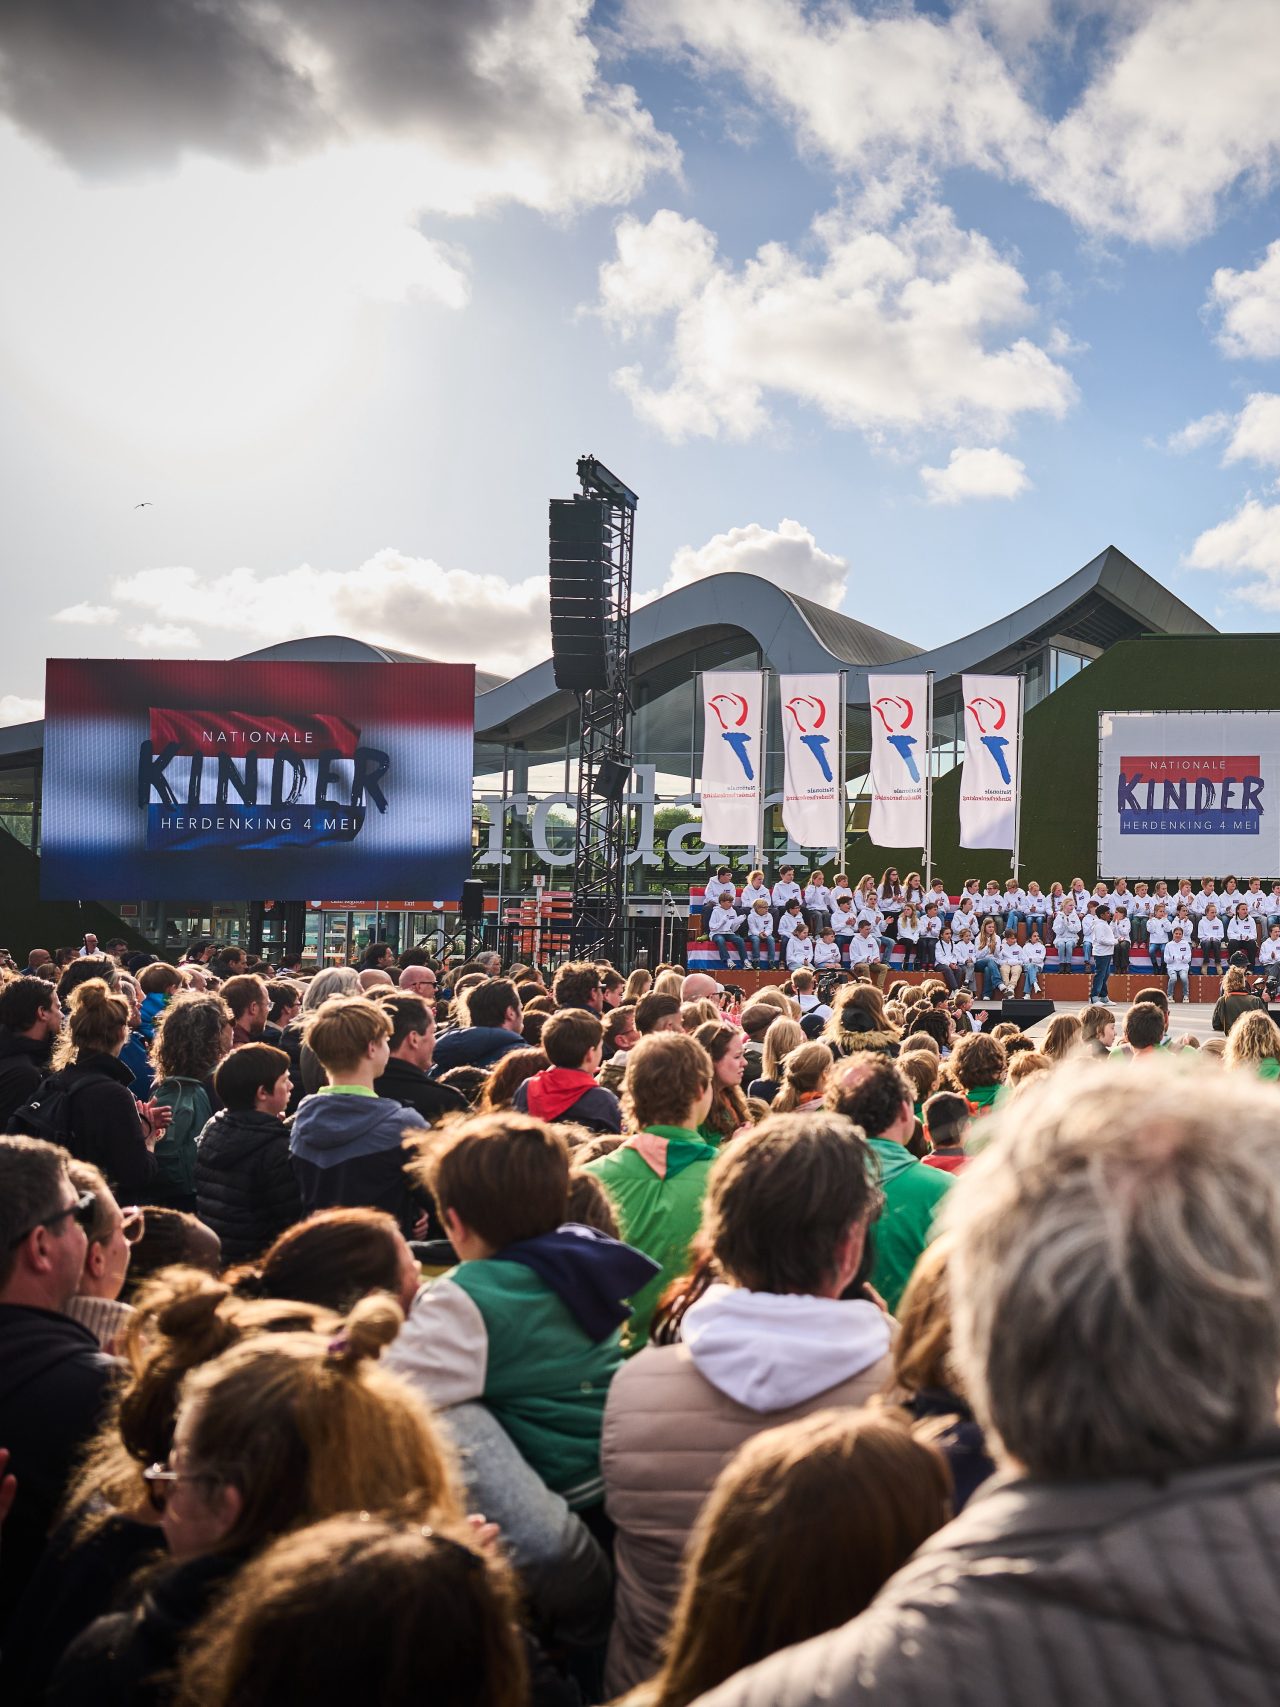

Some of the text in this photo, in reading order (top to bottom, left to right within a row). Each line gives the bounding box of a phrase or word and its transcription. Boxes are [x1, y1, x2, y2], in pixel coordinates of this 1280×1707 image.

[202, 731, 314, 744] NATIONALE
[1150, 760, 1227, 770] NATIONALE
[138, 740, 391, 815] KINDER
[1117, 772, 1265, 816] KINDER
[161, 817, 357, 831] HERDENKING 4 MEI
[1123, 821, 1258, 830] HERDENKING 4 MEI
